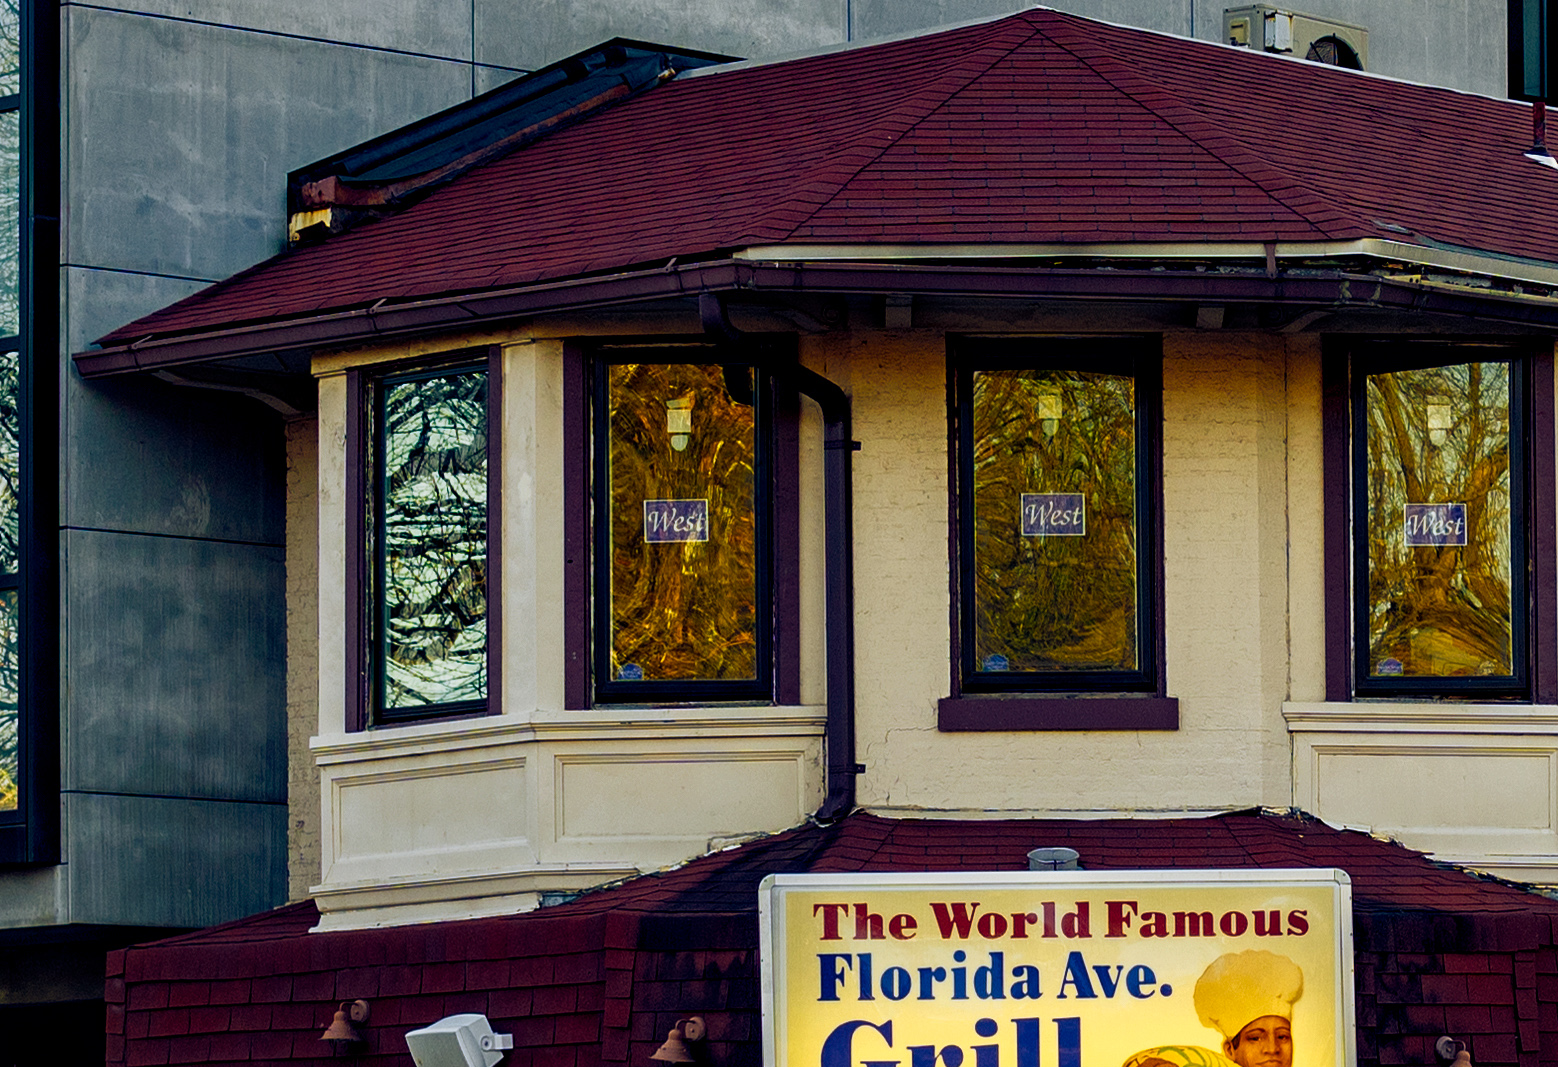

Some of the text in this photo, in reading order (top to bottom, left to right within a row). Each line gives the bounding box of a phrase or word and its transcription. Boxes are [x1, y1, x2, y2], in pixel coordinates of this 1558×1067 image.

[648, 507, 705, 532] West
[1025, 500, 1081, 526] West
[1407, 511, 1464, 536] West
[813, 900, 1309, 940] The World Famous
[816, 950, 1173, 1001] Florida Ave.
